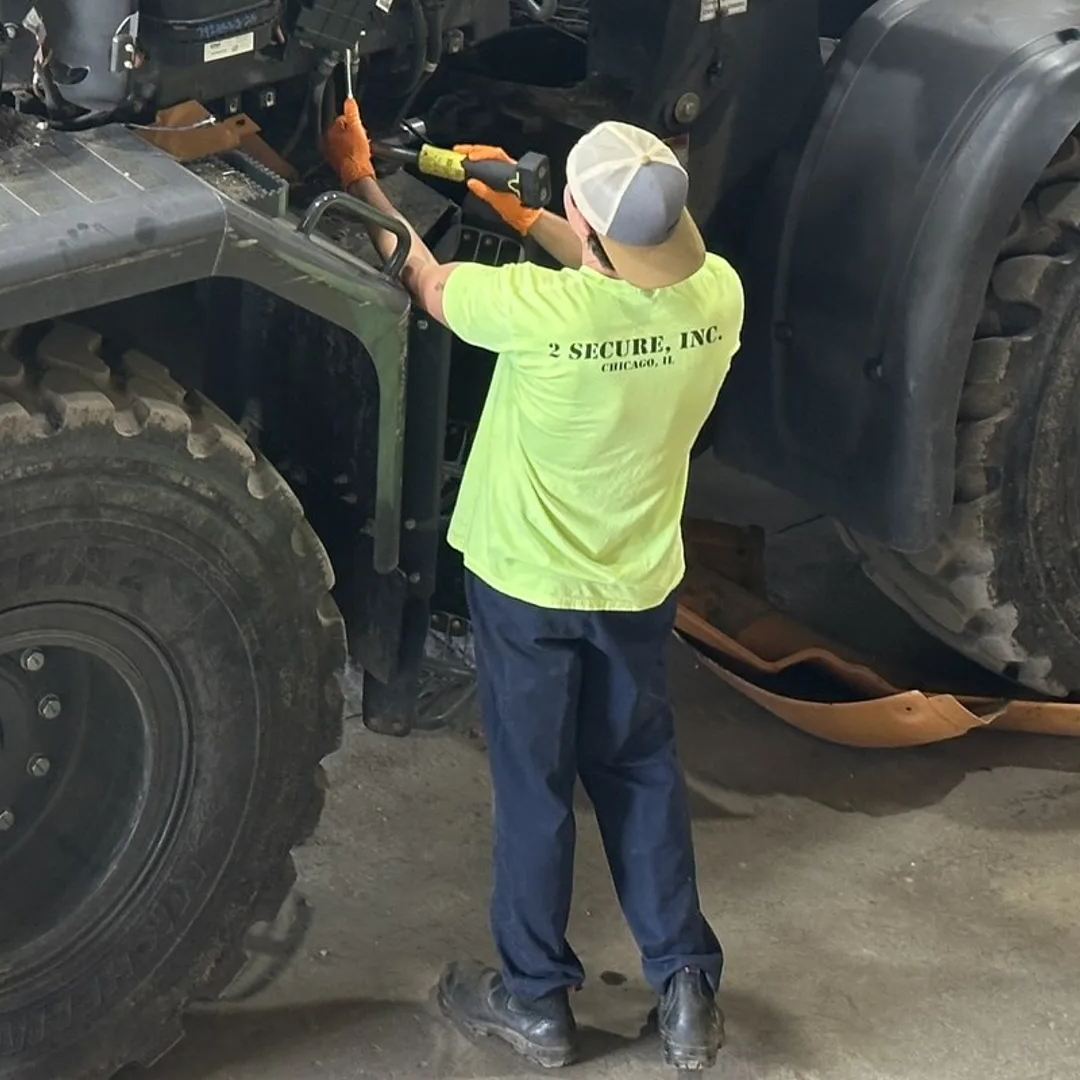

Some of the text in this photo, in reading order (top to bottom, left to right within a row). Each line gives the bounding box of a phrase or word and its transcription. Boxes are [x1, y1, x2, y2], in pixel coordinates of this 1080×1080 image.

[548, 324, 723, 361] 2 SECURE, INC.
[601, 356, 658, 373] CHICAGO,
